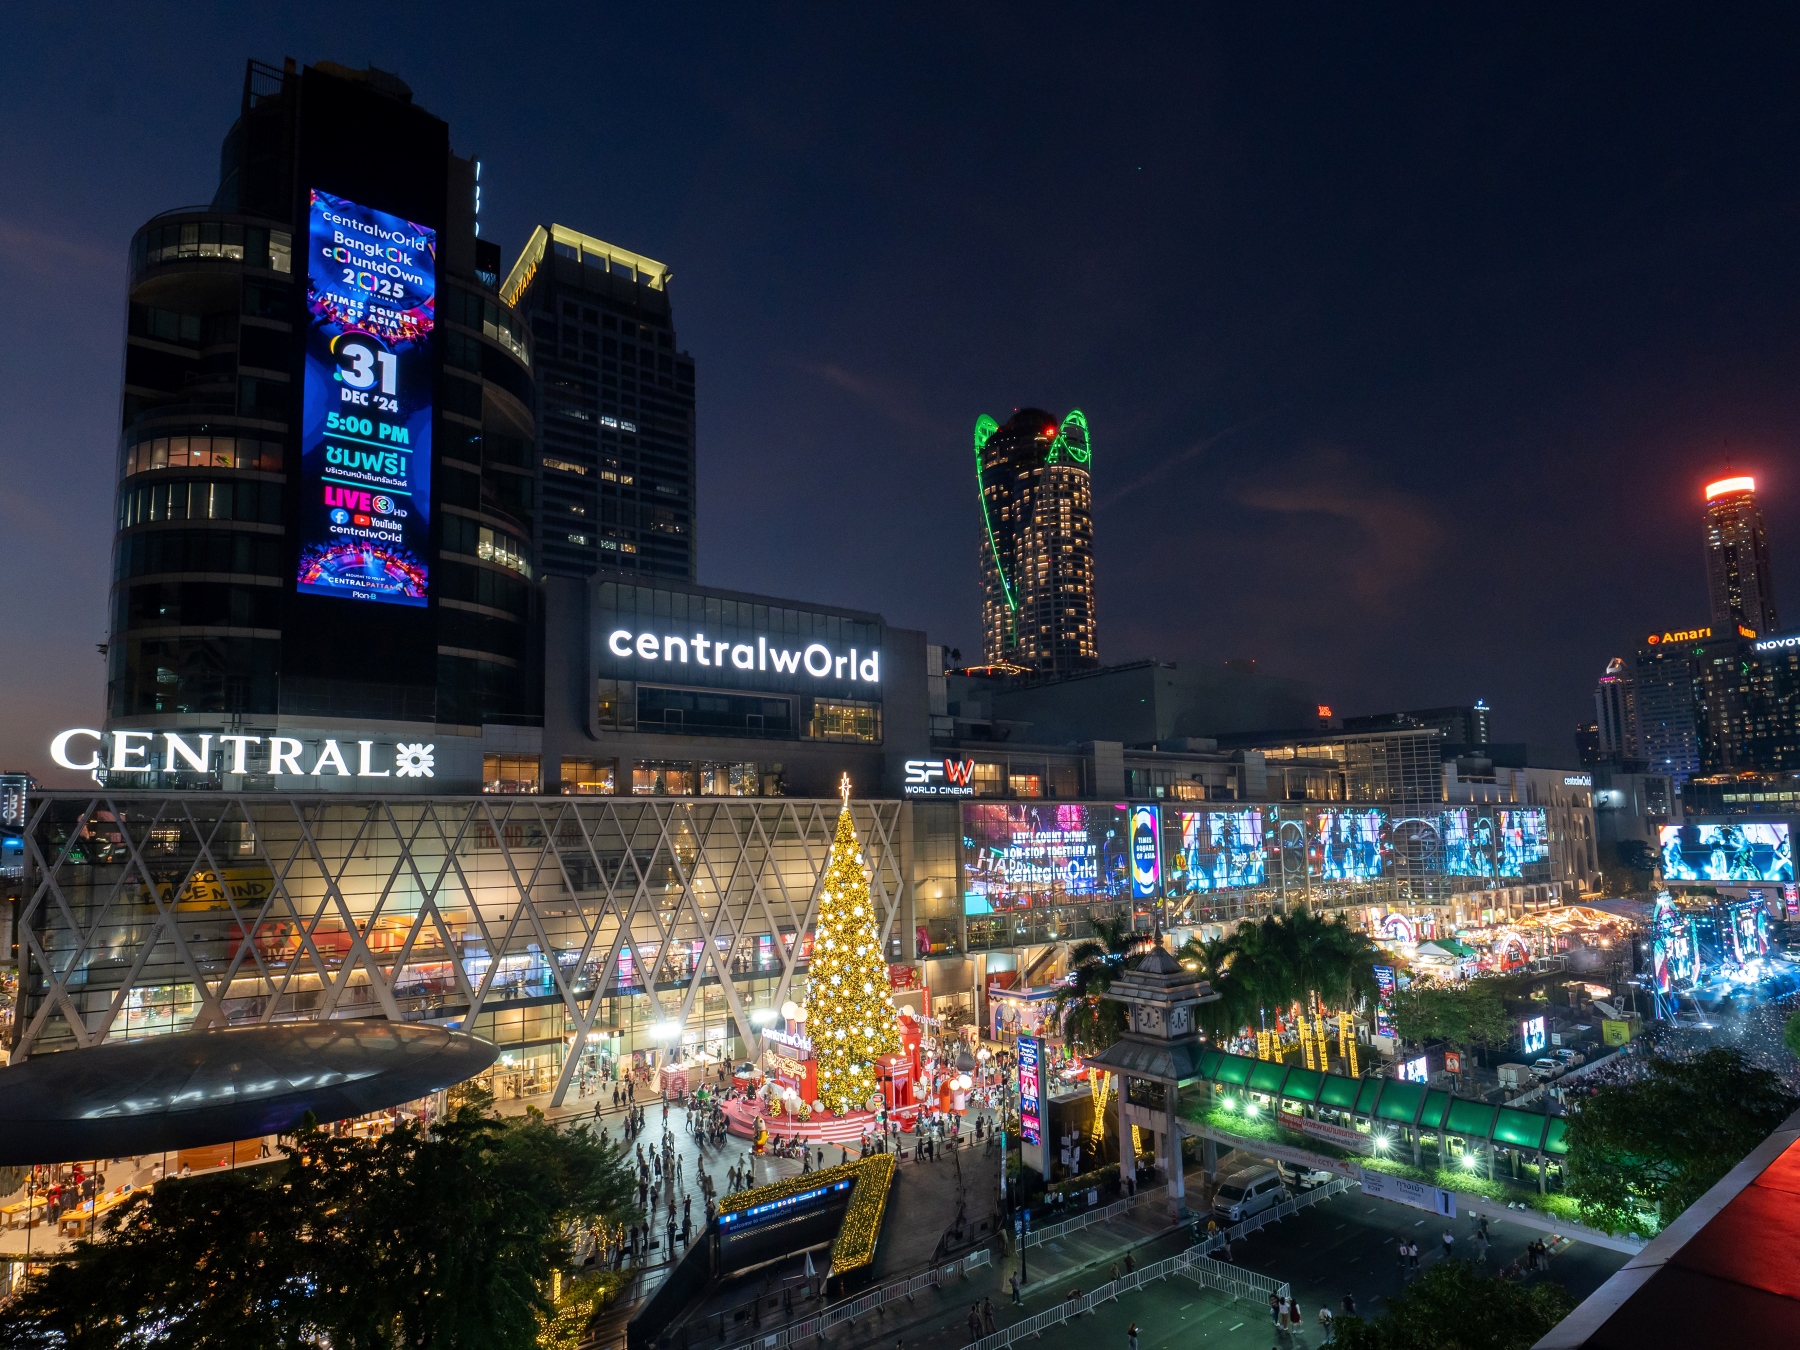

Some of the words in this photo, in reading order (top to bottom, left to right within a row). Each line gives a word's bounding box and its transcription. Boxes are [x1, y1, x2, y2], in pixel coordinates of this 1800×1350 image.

[365, 291, 397, 304] ORIGINAL
[326, 292, 364, 309] TIMES
[369, 305, 418, 325] SQUARE
[347, 308, 363, 318] OF
[341, 344, 397, 395] 31
[341, 388, 369, 406] DEC
[373, 395, 398, 413] '24
[326, 411, 373, 436] 5:00
[379, 422, 409, 444] PM
[326, 445, 406, 477] ชมฟรี!
[324, 486, 371, 511] LIVE
[394, 508, 407, 518] HD
[371, 516, 402, 531] YouTube
[1661, 627, 1712, 644] Amari
[608, 629, 880, 683] centralwOrld
[50, 728, 391, 778] CENTRAL
[904, 785, 937, 794] WORLD
[939, 786, 973, 795] CINEMA
[476, 825, 524, 848] TRND
[1012, 831, 1034, 844] LET'S
[1036, 831, 1062, 843] COUNT
[1063, 830, 1087, 843] DOWN
[1137, 836, 1152, 844] TIMES
[1003, 846, 1045, 860] NON-STOP
[1047, 845, 1086, 858] TOGETHER
[1086, 845, 1097, 857] AT
[1136, 844, 1155, 852] SQUARE
[1136, 852, 1143, 860] OF
[1318, 1158, 1335, 1167] CCTV
[1396, 1180, 1424, 1194] ทางเข้า
[1400, 1188, 1421, 1197] Entrance
[729, 1219, 753, 1231] welcome
